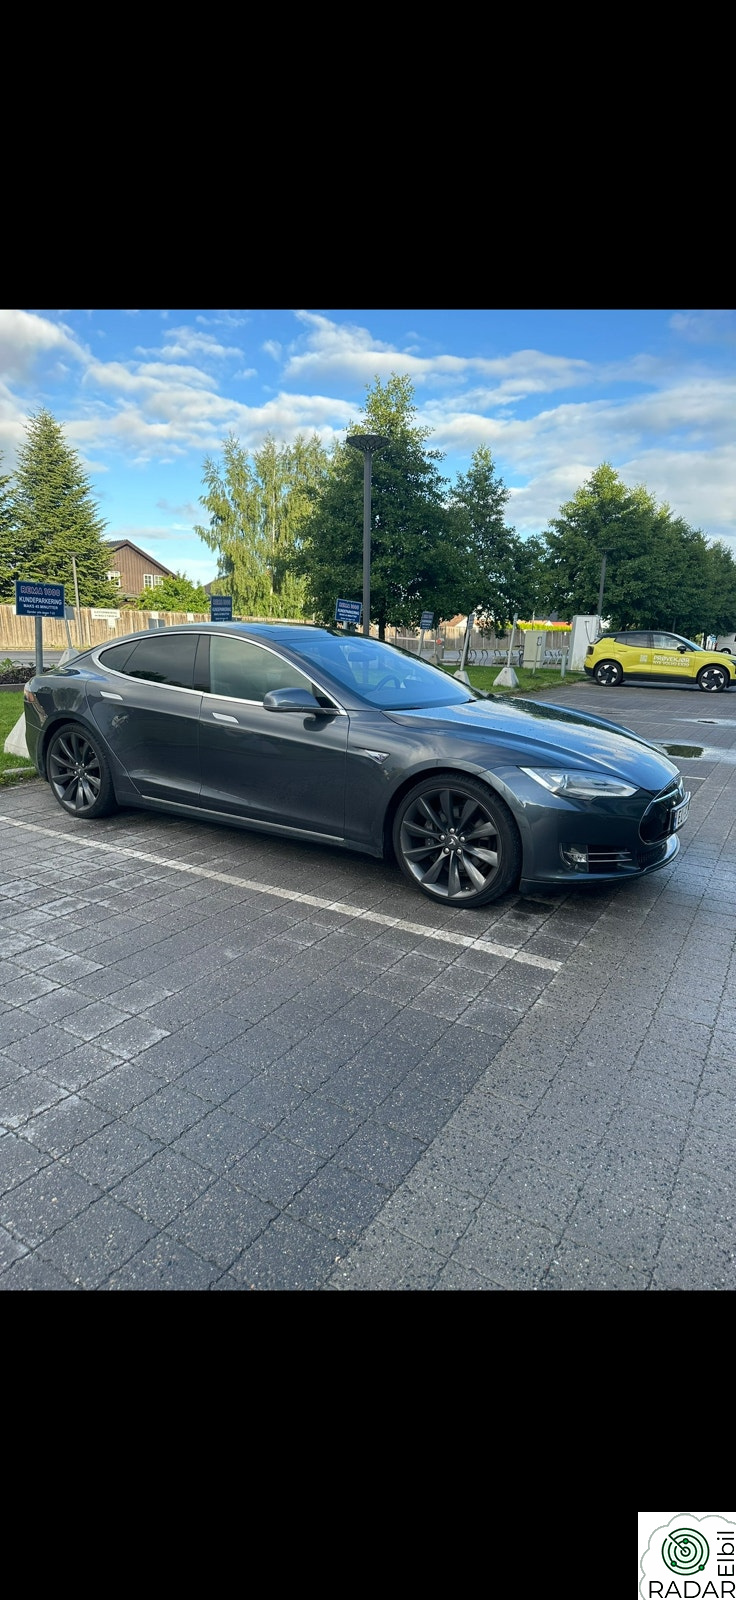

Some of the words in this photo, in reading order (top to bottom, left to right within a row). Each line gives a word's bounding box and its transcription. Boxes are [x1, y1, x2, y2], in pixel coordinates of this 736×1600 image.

[20, 585, 43, 595] REMA
[43, 587, 61, 597] 1000
[18, 596, 62, 605] KUNDEPARKERING
